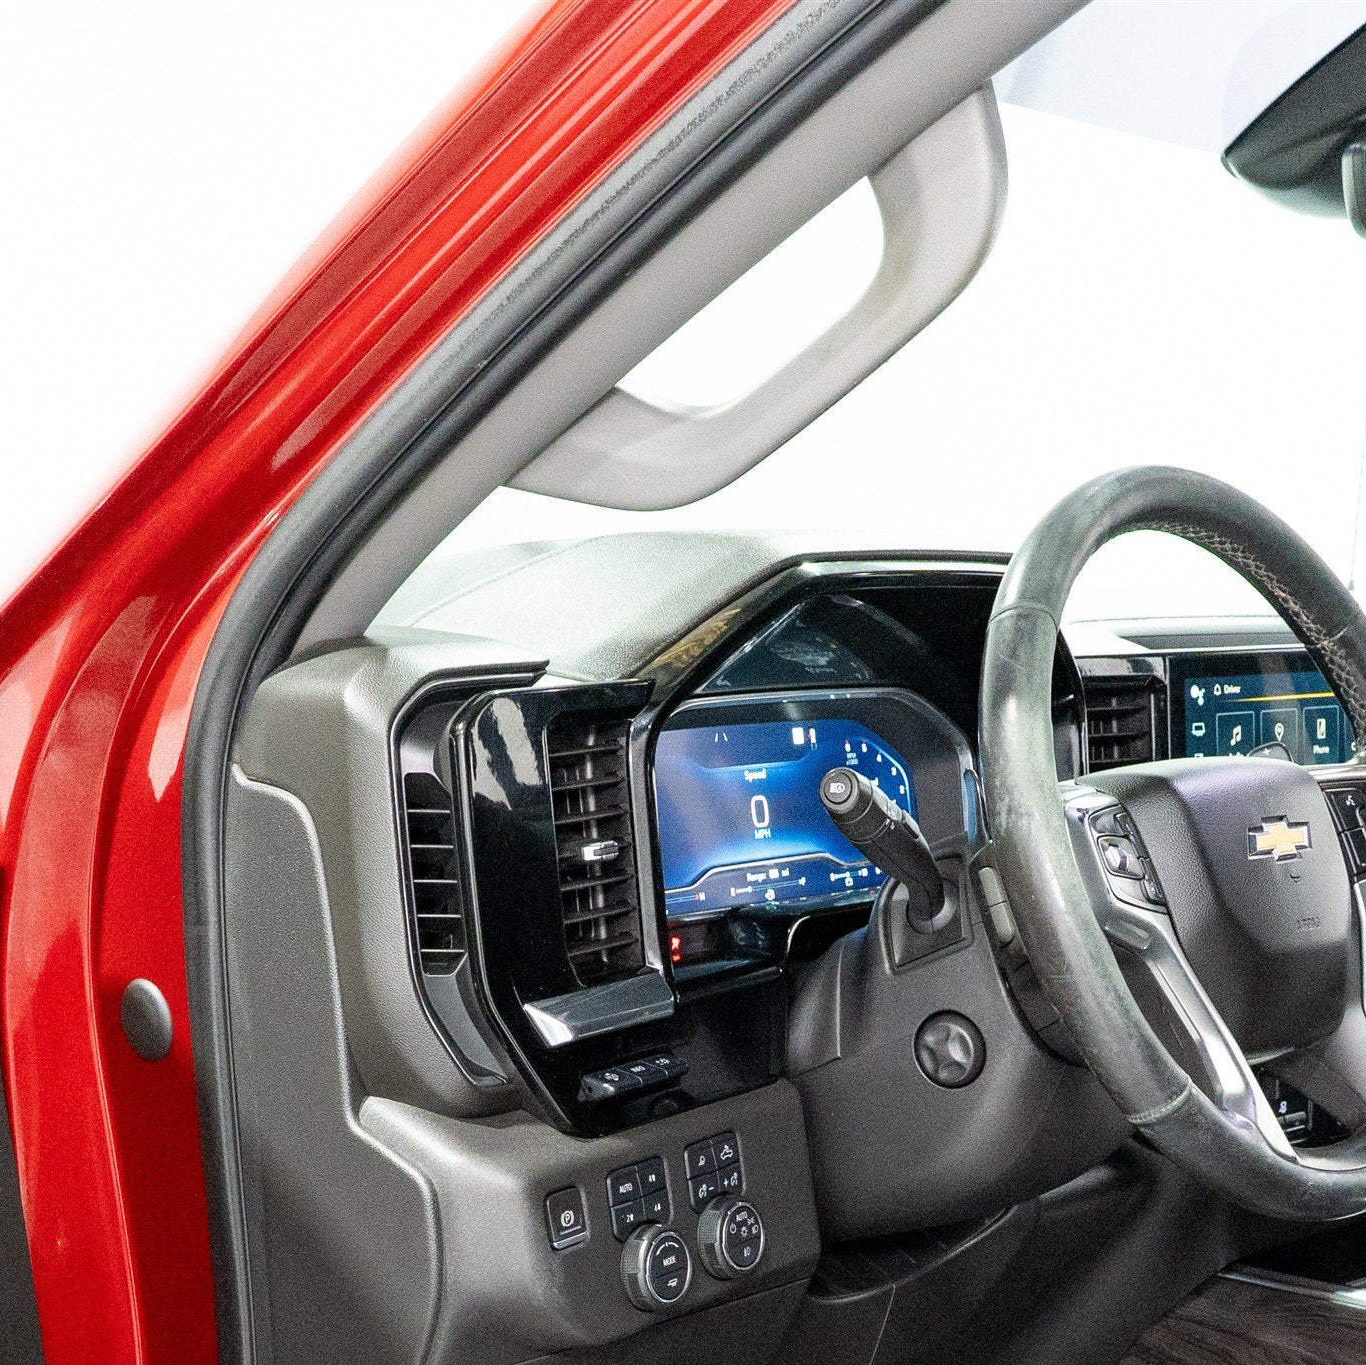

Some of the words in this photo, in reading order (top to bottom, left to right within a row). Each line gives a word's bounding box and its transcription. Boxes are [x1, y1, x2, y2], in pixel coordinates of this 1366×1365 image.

[744, 768, 767, 782] Speed
[750, 794, 770, 828] 0
[754, 828, 772, 840] MPH
[619, 1182, 633, 1194] AUTO
[662, 1255, 676, 1267] MODE
